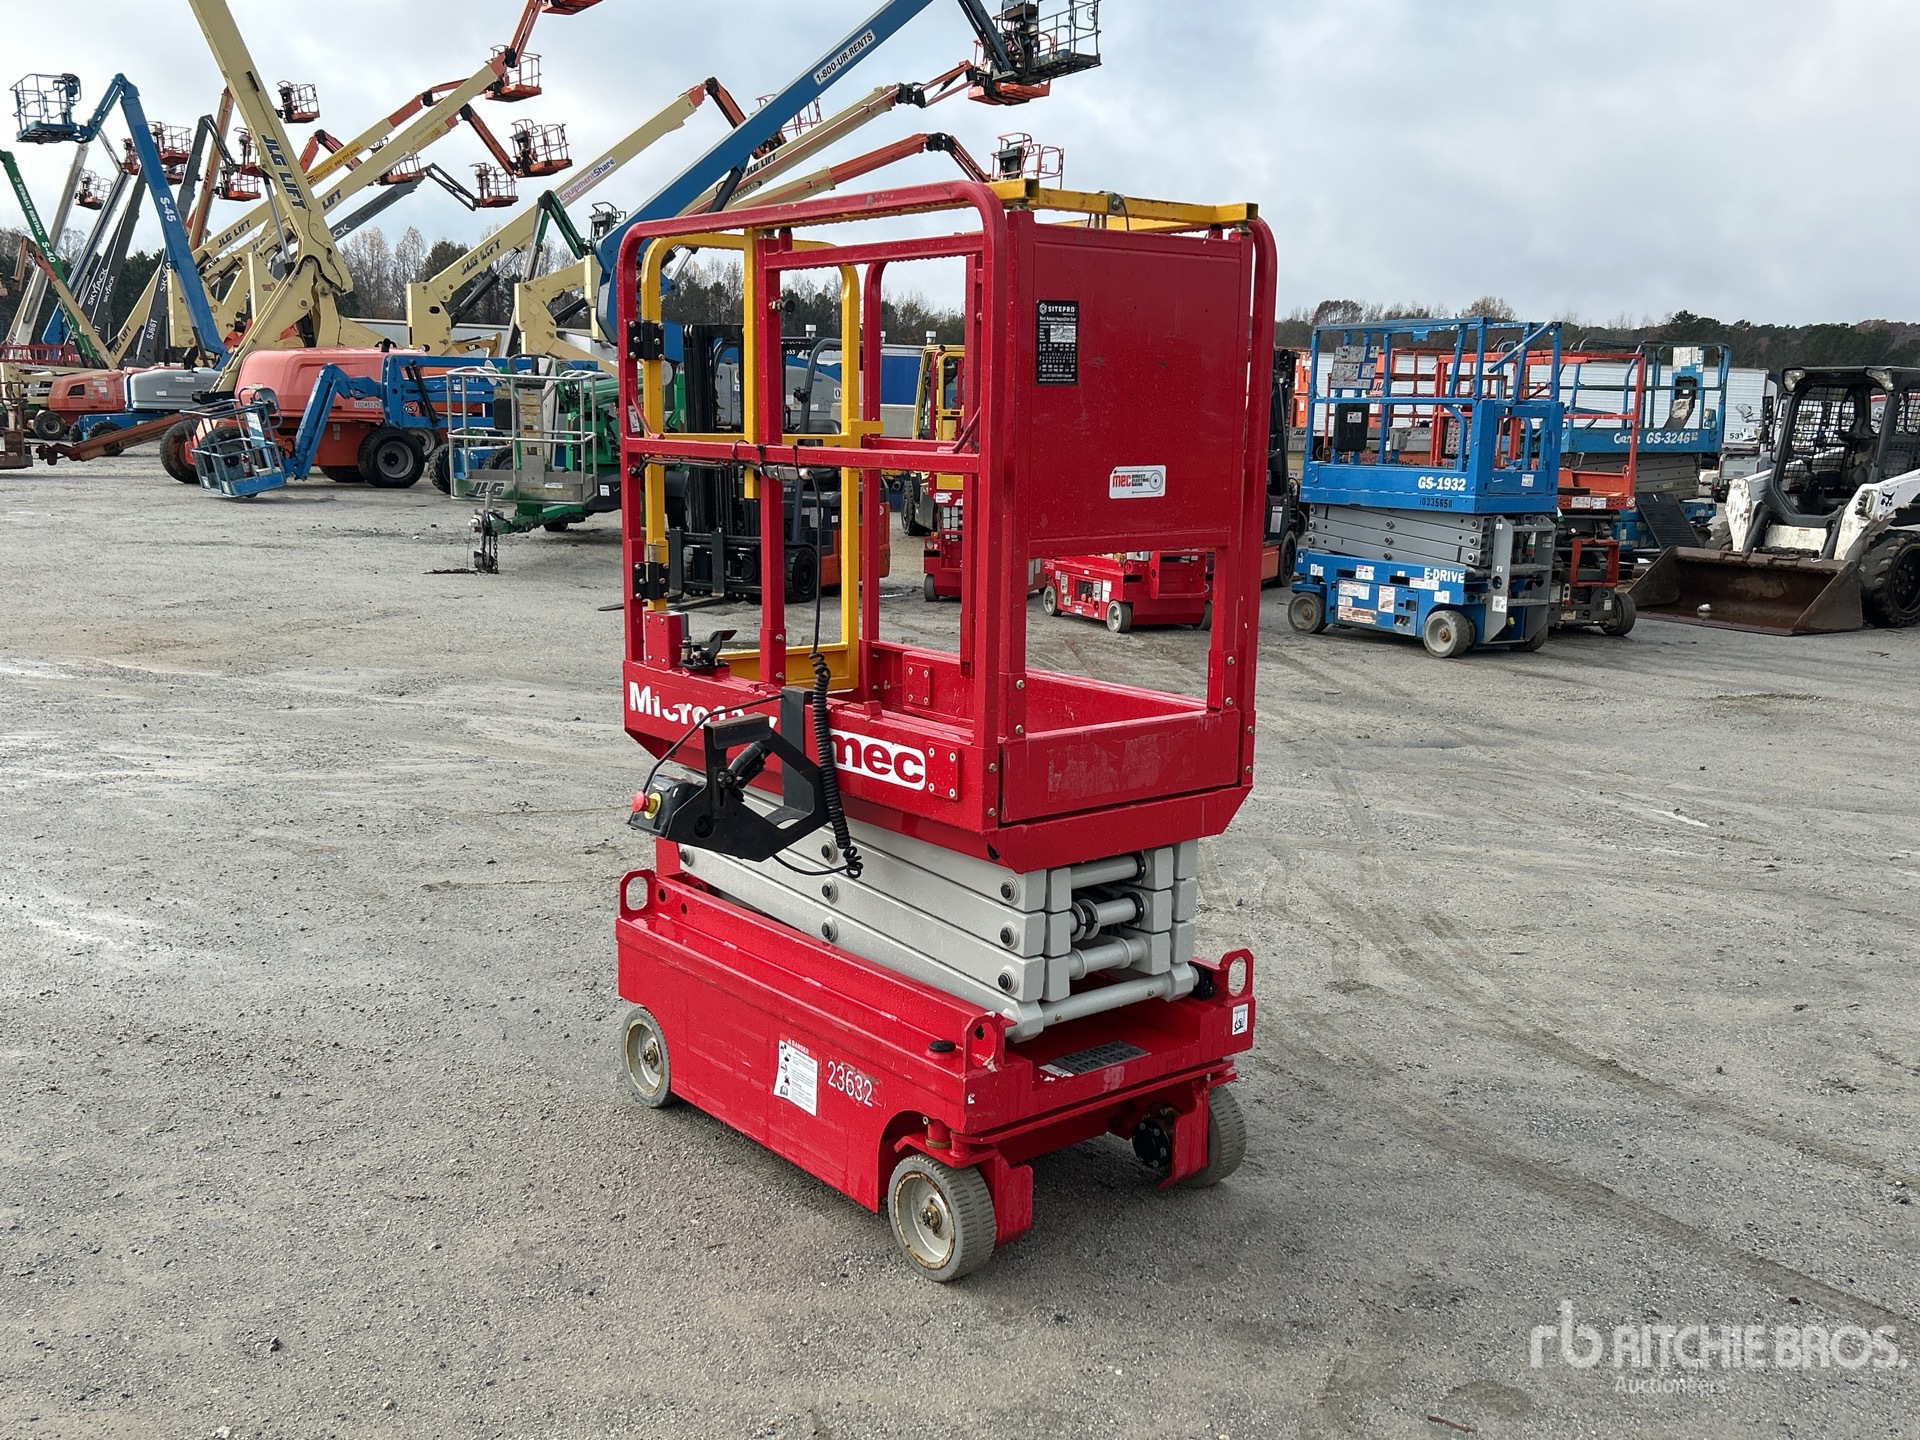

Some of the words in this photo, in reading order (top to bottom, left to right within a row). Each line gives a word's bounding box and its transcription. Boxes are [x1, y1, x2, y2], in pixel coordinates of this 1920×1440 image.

[815, 32, 874, 82] 1-800-UR-RENTS
[261, 135, 288, 167] JLG
[278, 172, 307, 210] LIFT
[559, 158, 616, 202] EquipmentShare
[159, 196, 177, 222] S-45
[321, 189, 342, 211] LIFT
[218, 234, 233, 249] JLG
[233, 219, 252, 236] LIFT
[41, 241, 57, 263] S-40
[87, 267, 108, 306] SKYJACK
[103, 275, 115, 304] SKYJACK
[1047, 305, 1076, 313] SITEPRO
[120, 324, 132, 342] LIFT
[146, 318, 158, 340] SJ66T
[1645, 430, 1691, 444] GS-3246
[465, 482, 505, 497] JLG
[1112, 474, 1132, 488] mec
[1417, 475, 1467, 492] GS-1932
[831, 733, 925, 785] mec
[826, 1060, 874, 1108] 23632
